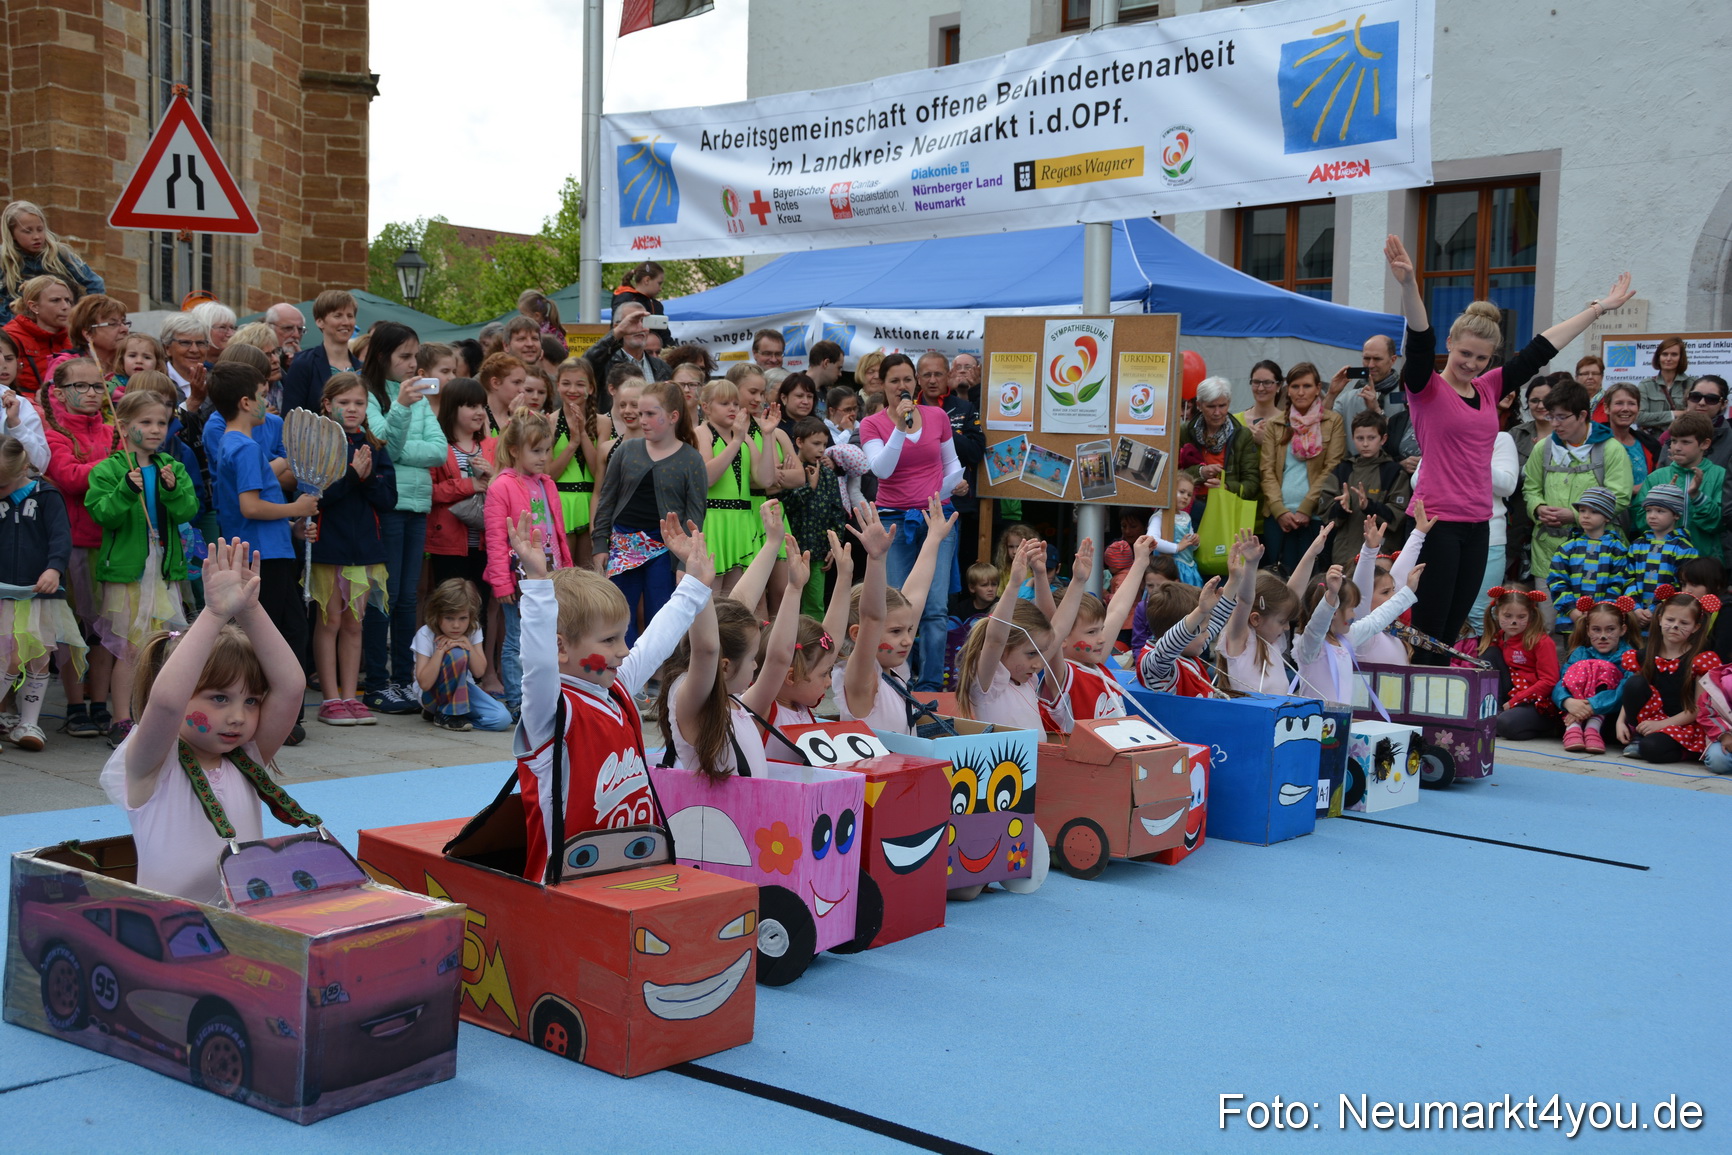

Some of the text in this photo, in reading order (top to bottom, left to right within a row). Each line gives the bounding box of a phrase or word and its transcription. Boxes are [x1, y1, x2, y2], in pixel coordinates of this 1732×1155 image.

[700, 39, 1235, 151] Arbeitsgemeinschaft offene Behindertenarbeit
[768, 98, 1129, 176] im Landkreis Neumarkt i.d.OPf.
[911, 163, 958, 180] Diakonie
[1041, 157, 1135, 184] Regens Wagner
[851, 179, 881, 190] Caritas-
[913, 175, 1003, 196] Nürnberger Land
[773, 185, 826, 199] Bayerisches
[850, 189, 899, 203] Sozialstation
[775, 200, 799, 212] Rotes
[852, 202, 908, 217] Neumarkt e.V.
[915, 195, 966, 212] Neumarkt
[777, 214, 802, 224] Kreuz
[873, 327, 975, 340] Aktionen zur
[1051, 324, 1108, 342] SYMPATHIEBLUME
[995, 355, 1032, 363] URKUNDE
[1124, 355, 1166, 363] URKUNDE
[95, 972, 116, 1002] 95
[328, 985, 340, 996] 95
